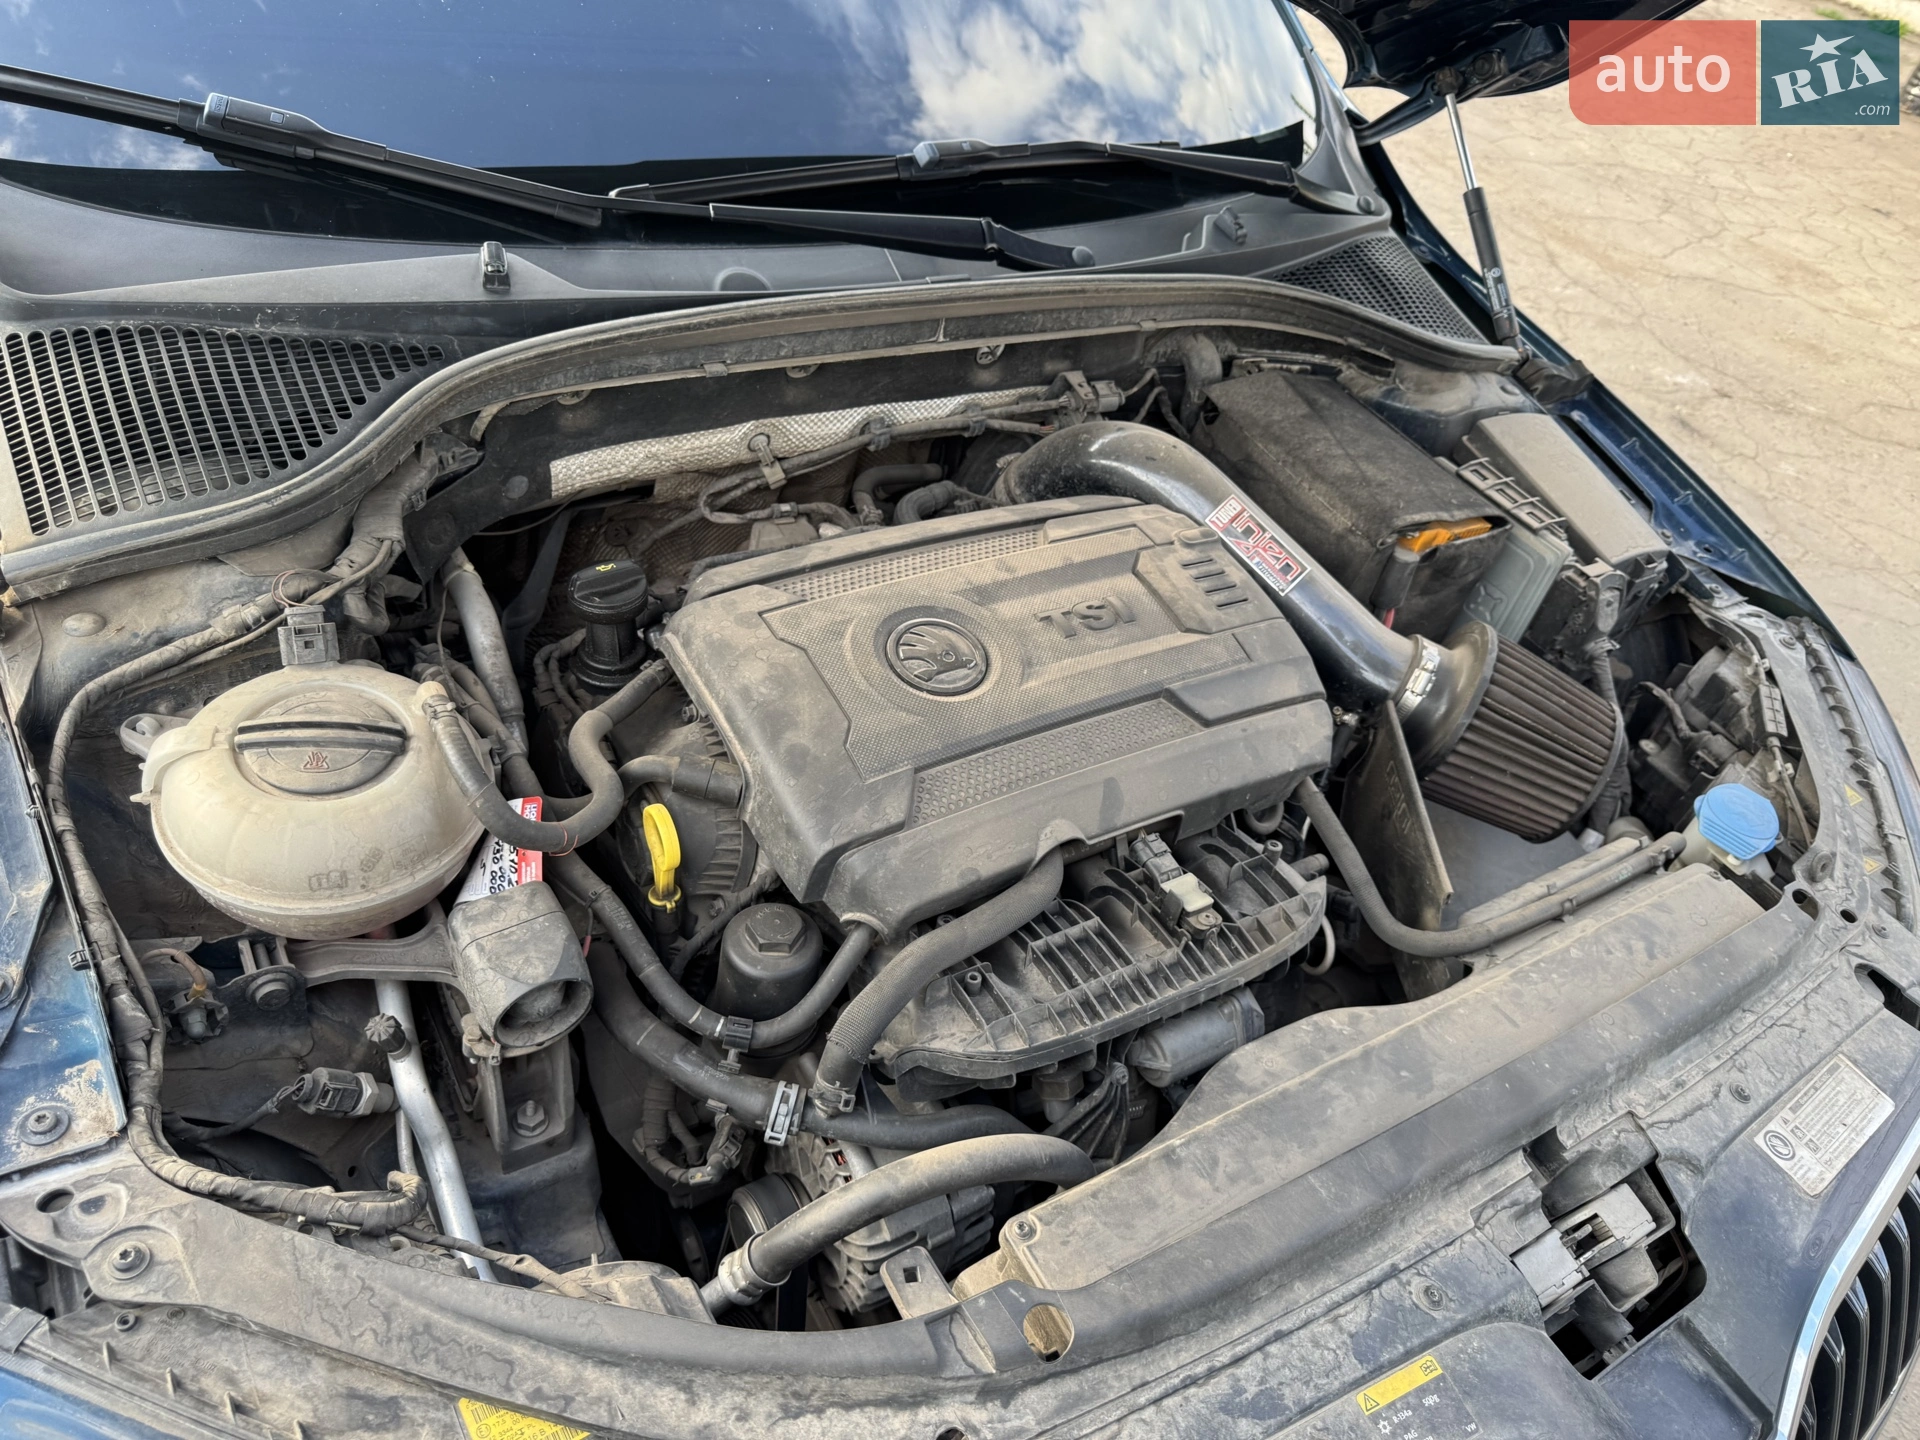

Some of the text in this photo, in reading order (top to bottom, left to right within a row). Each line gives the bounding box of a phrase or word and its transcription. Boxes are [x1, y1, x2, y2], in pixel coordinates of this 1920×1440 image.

[1227, 510, 1302, 580] injen
[1033, 596, 1137, 639] TSI
[1392, 1409, 1413, 1424] R-134a
[1403, 1429, 1418, 1440] PAG
[1465, 1421, 1477, 1433] VW
